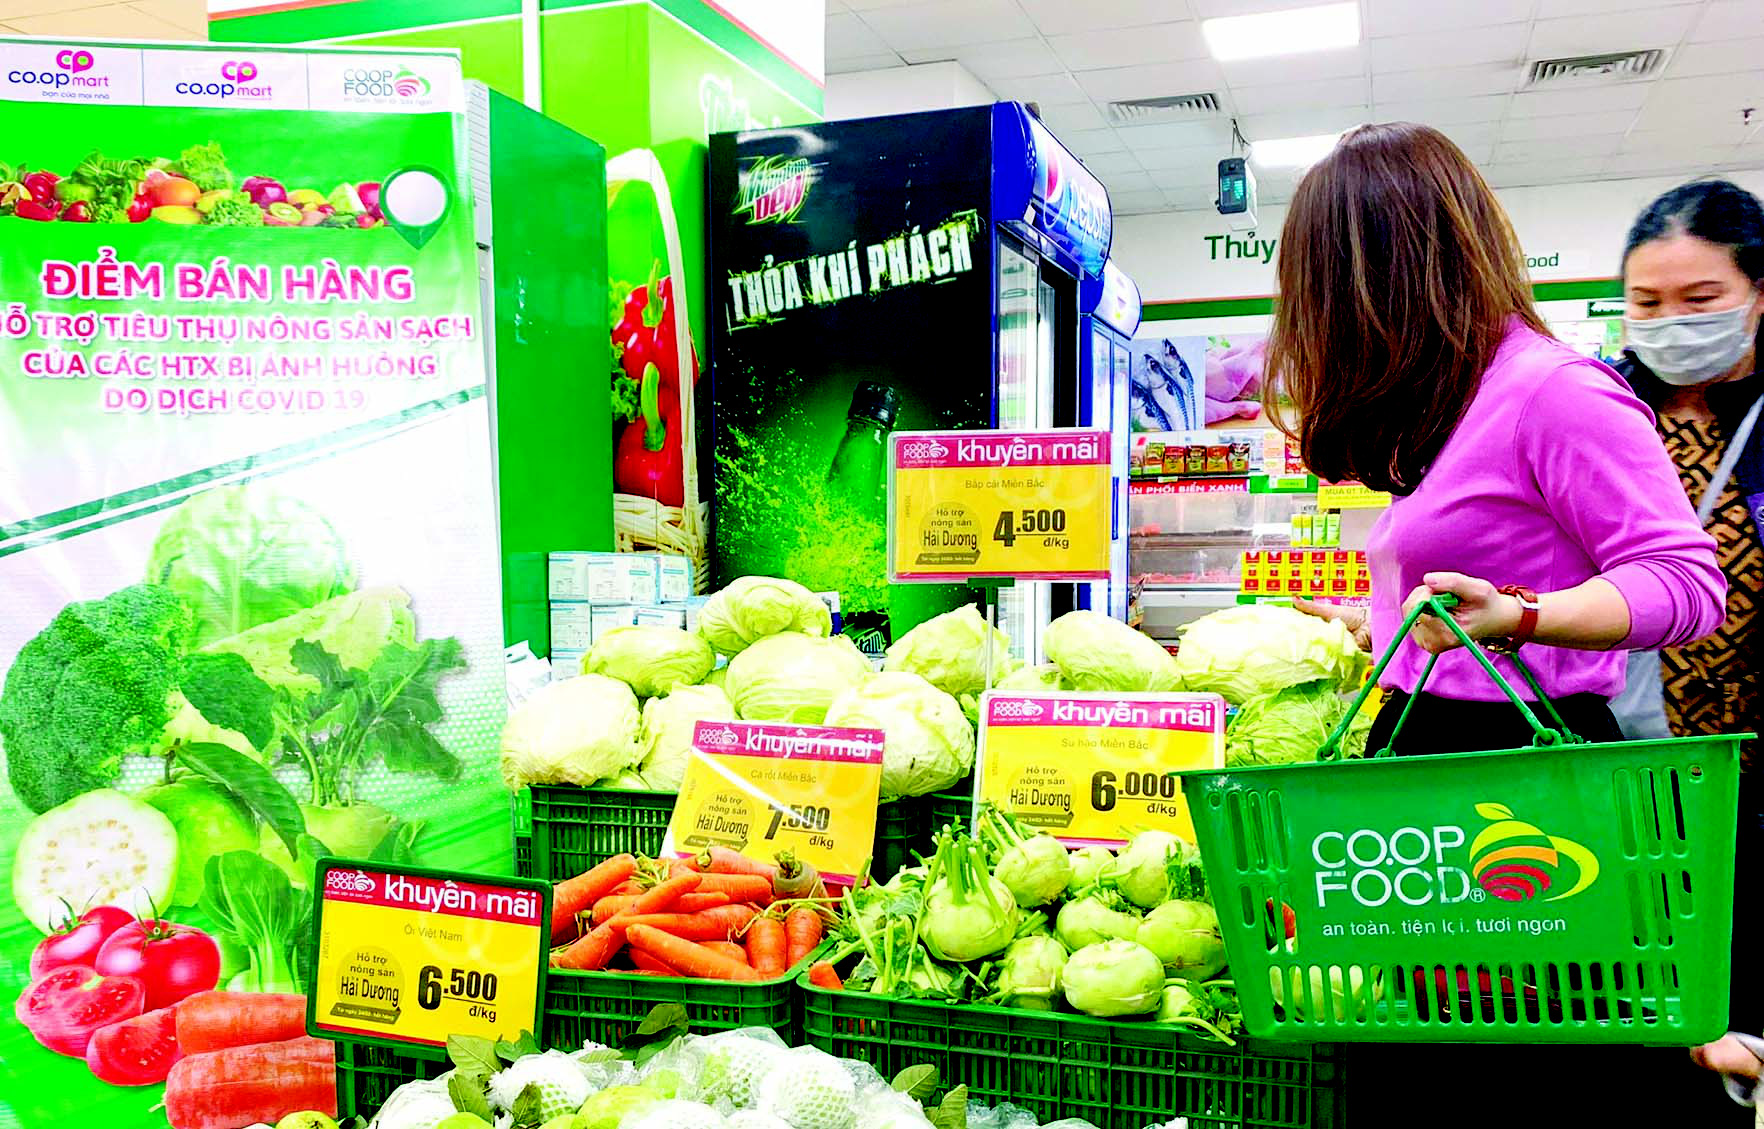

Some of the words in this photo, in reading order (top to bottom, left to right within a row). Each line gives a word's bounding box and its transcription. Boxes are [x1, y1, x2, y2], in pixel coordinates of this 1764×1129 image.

[344, 83, 394, 96] FOOD
[1204, 231, 1277, 265] Thủy
[1525, 252, 1559, 268] ood
[42, 248, 161, 298] ĐIỂM
[178, 259, 268, 299] BÁN
[285, 260, 412, 300] HÀNG
[728, 254, 804, 322] THỎA
[808, 240, 863, 305] KHÍ
[867, 225, 973, 291] PHÁCH
[0, 305, 27, 335] Ỗ
[36, 314, 96, 342] TRỢ
[104, 314, 169, 338] TIÊU
[176, 318, 238, 344] THỤ
[247, 315, 330, 340] NÔNG
[339, 314, 393, 340] SẢN
[401, 317, 471, 344] SẠCH
[24, 348, 86, 375] CỦA
[94, 350, 152, 376] CÁC
[162, 355, 218, 376] HTX
[228, 356, 252, 382] BỊ
[261, 352, 321, 377] ẢNH
[105, 388, 148, 410] DO
[158, 388, 228, 414] DỊCH
[238, 389, 325, 410] COVID
[333, 390, 365, 410] 19
[1052, 436, 1098, 460] mãi
[1208, 482, 1244, 492] XANH
[943, 530, 977, 550] Dương
[1043, 534, 1069, 549] đ/kg
[1159, 700, 1211, 727] mãi
[1031, 788, 1071, 812] Dương
[1147, 802, 1177, 816] đ/kg
[714, 815, 749, 839] Dương
[809, 834, 834, 850] đ/kg
[1312, 825, 1465, 869] CO.OP
[1315, 866, 1472, 908] FOOD
[486, 890, 537, 919] mãi
[439, 928, 463, 942] Nam
[1322, 923, 1344, 937] an
[1401, 919, 1435, 937] tiện
[1476, 917, 1511, 934] tươi
[1517, 918, 1567, 935] ngon
[373, 955, 387, 966] trợ
[361, 978, 399, 1008] Dương
[468, 1007, 497, 1023] đ/kg
